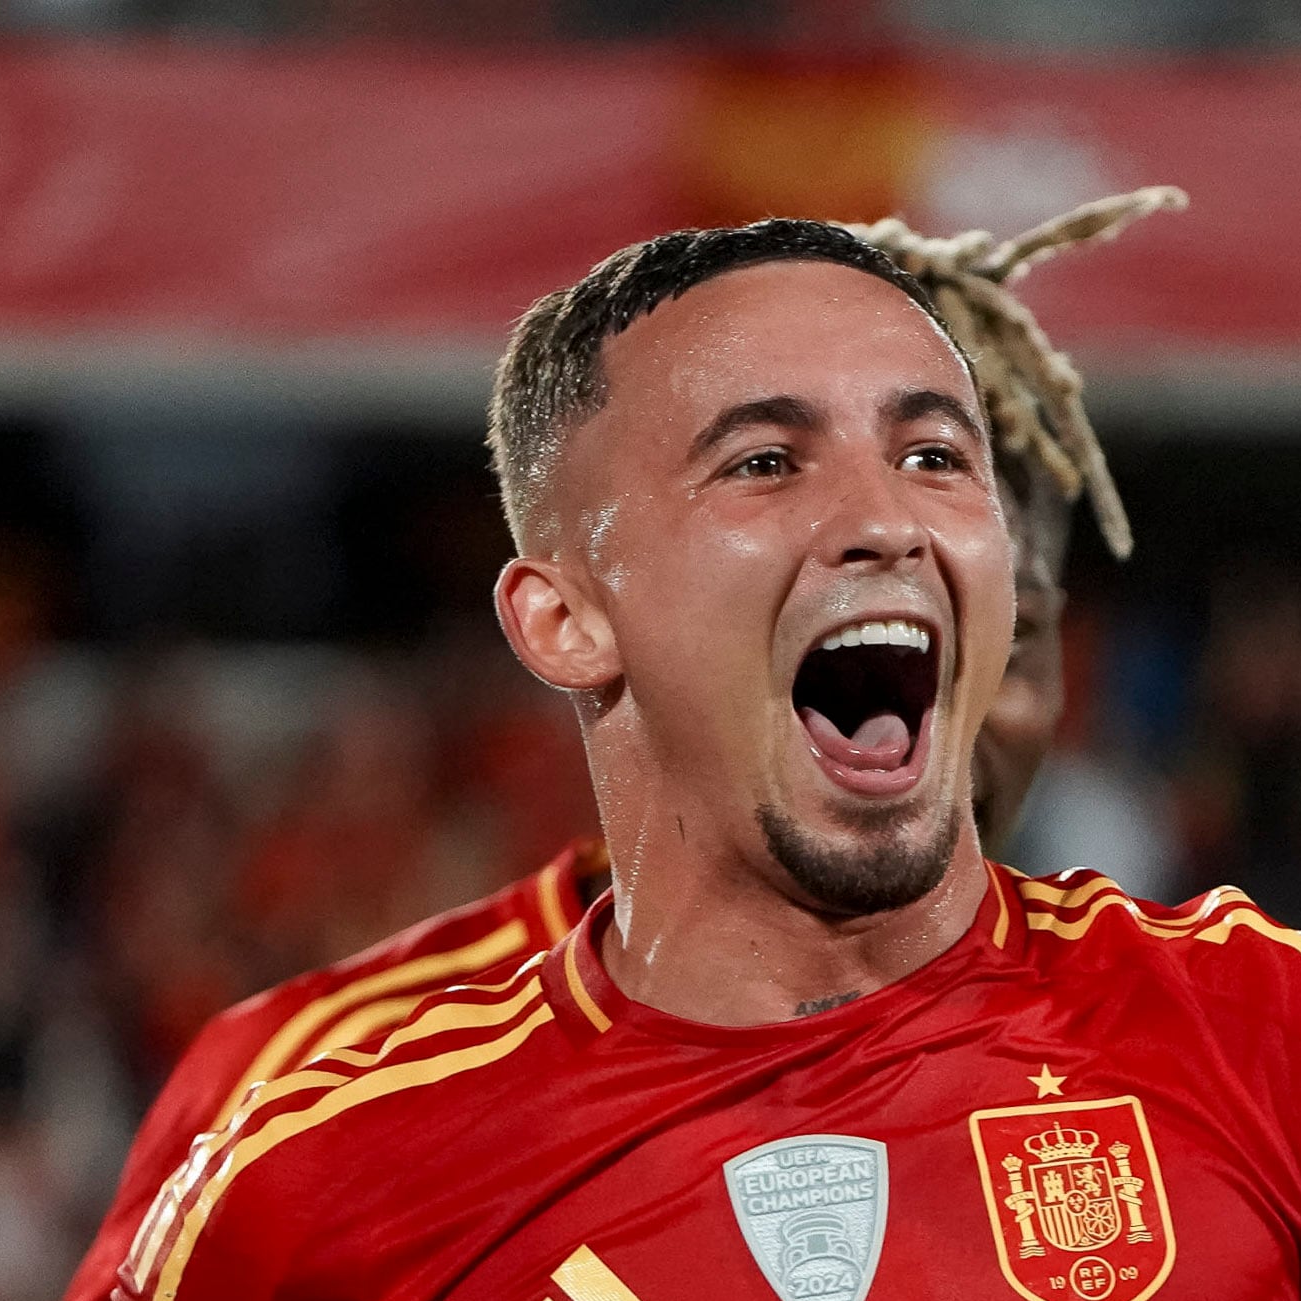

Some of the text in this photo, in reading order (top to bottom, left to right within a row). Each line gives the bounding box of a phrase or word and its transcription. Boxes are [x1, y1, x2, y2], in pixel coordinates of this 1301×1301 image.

[778, 1149, 829, 1168] UEFA
[745, 1162, 871, 1194] EUROPEAN
[748, 1183, 874, 1214] CHAMPIONS
[1049, 1276, 1066, 1290] 19
[1119, 1266, 1139, 1281] 09
[794, 1273, 854, 1296] 2024
